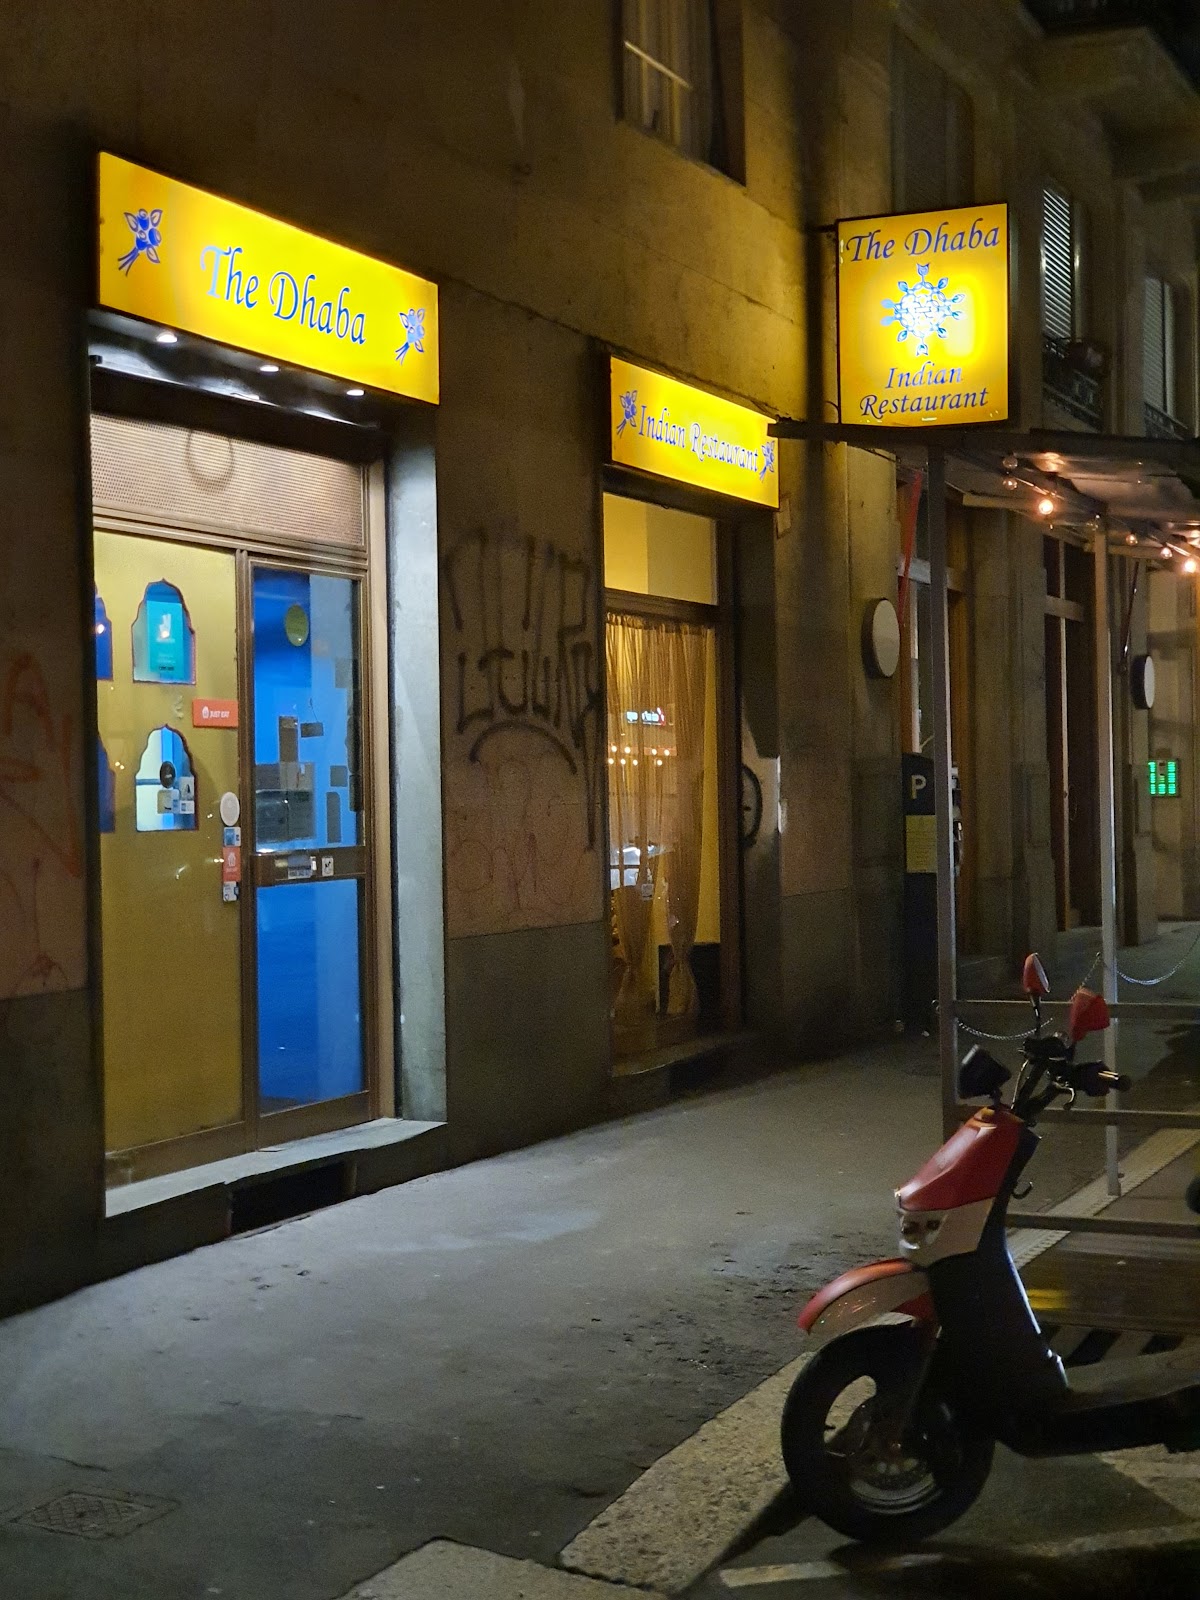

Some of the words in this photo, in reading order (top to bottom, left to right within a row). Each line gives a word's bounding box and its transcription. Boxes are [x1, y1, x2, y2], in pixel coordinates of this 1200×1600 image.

[846, 230, 895, 262] The
[904, 218, 1000, 256] Dhaba
[201, 246, 259, 308] The
[270, 271, 366, 345] Dhaba
[885, 361, 962, 389] Indian
[859, 387, 988, 419] Restaurant
[639, 405, 685, 448] Indian
[690, 423, 759, 472] Restaurant
[911, 775, 927, 799] P
